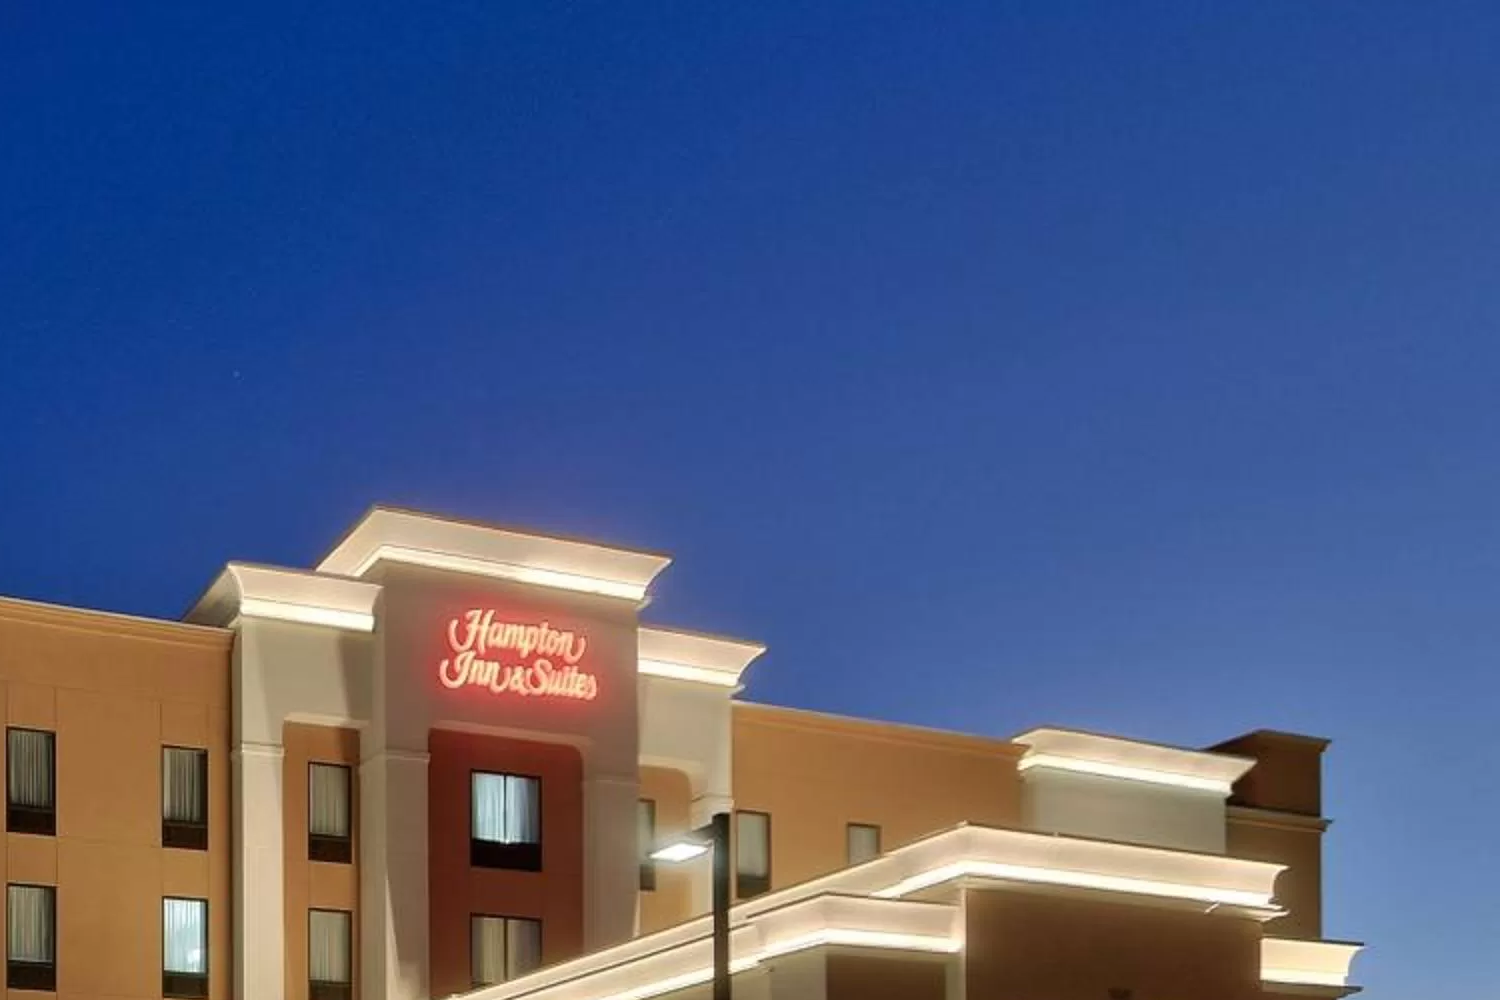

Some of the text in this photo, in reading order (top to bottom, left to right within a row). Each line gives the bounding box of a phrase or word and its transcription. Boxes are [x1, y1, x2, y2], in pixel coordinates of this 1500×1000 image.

[449, 608, 586, 664] Hampton
[439, 650, 597, 700] Inn & Suites
